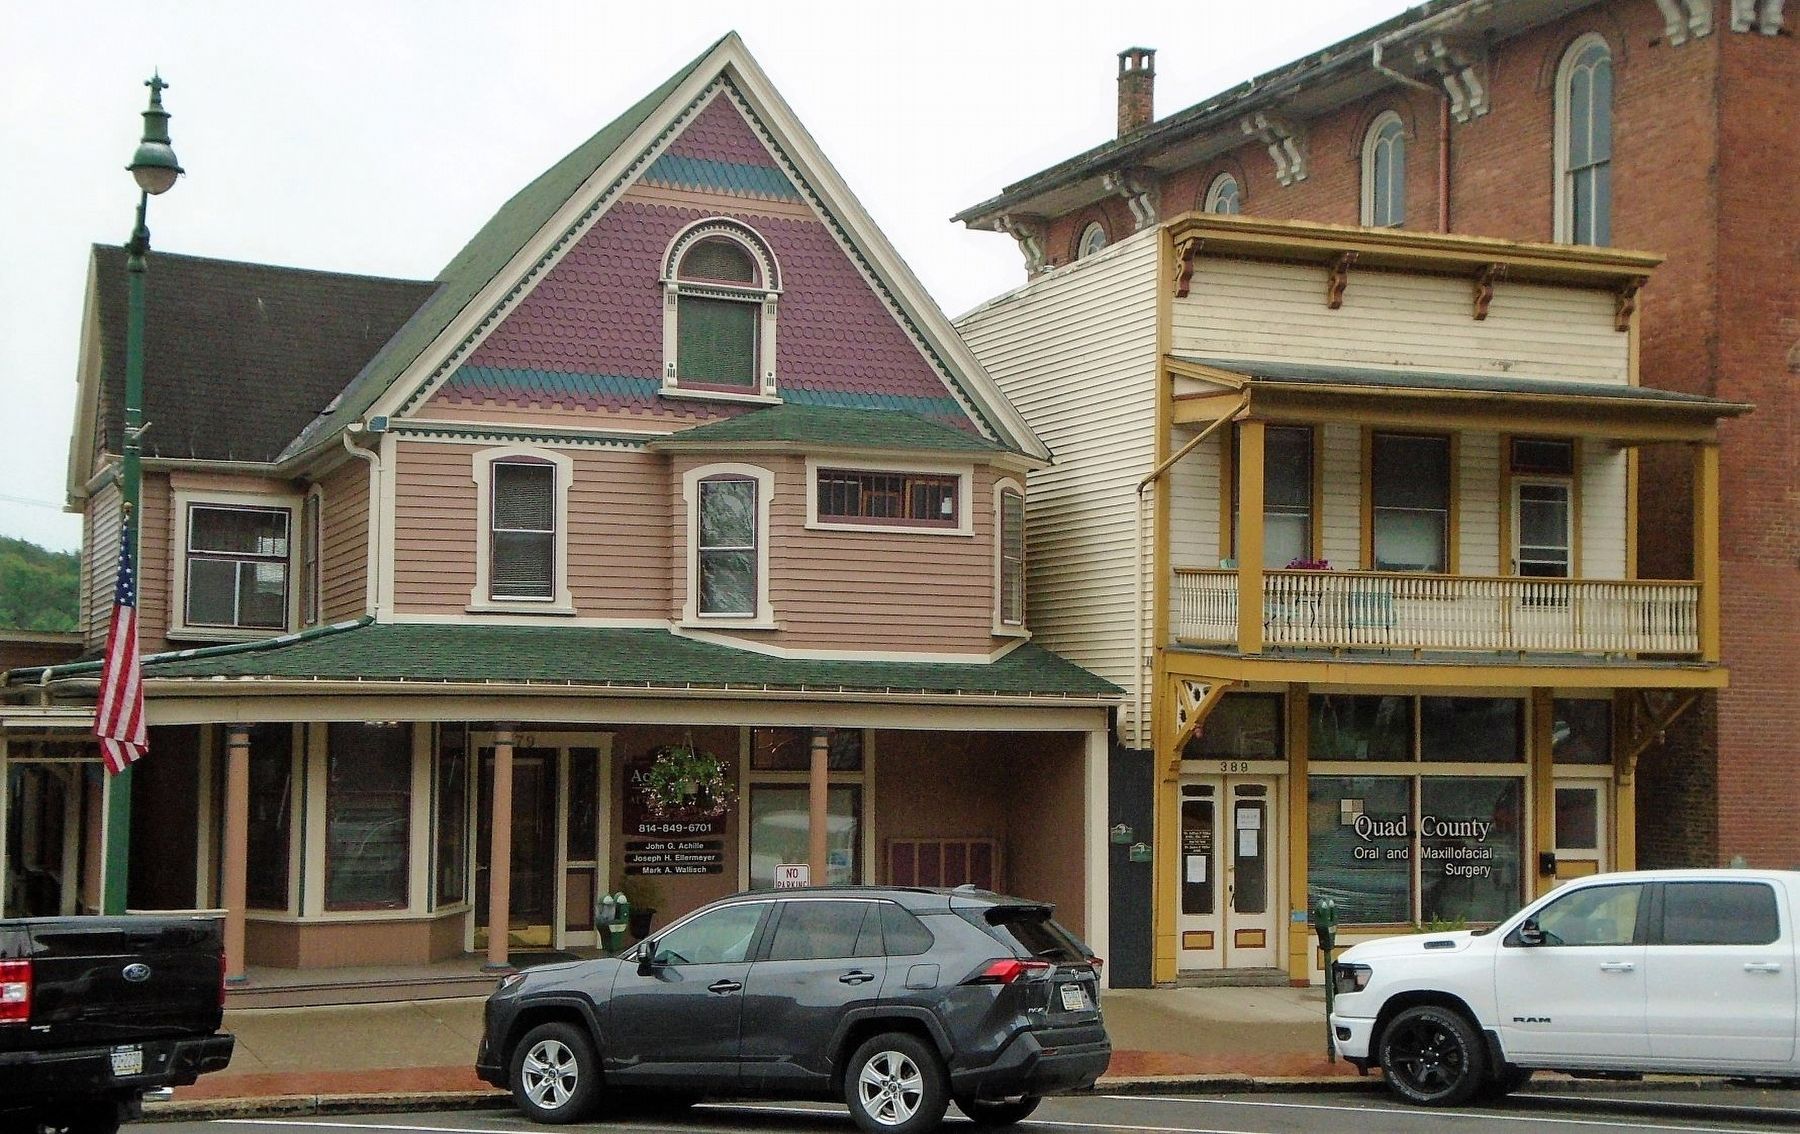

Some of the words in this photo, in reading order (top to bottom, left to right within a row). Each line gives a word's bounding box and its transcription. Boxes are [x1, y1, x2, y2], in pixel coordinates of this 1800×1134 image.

[1220, 761, 1248, 773] 389
[638, 823, 712, 833] 814-849-6701
[1354, 815, 1408, 841] Quad
[1420, 815, 1491, 842] County
[1354, 846, 1380, 859] Oral
[1386, 846, 1410, 859] and
[1420, 846, 1494, 859] Maxillofacial
[633, 854, 662, 863] Joseph
[642, 866, 662, 874] Mark
[786, 868, 799, 878] NO
[1445, 863, 1491, 878] Surgery
